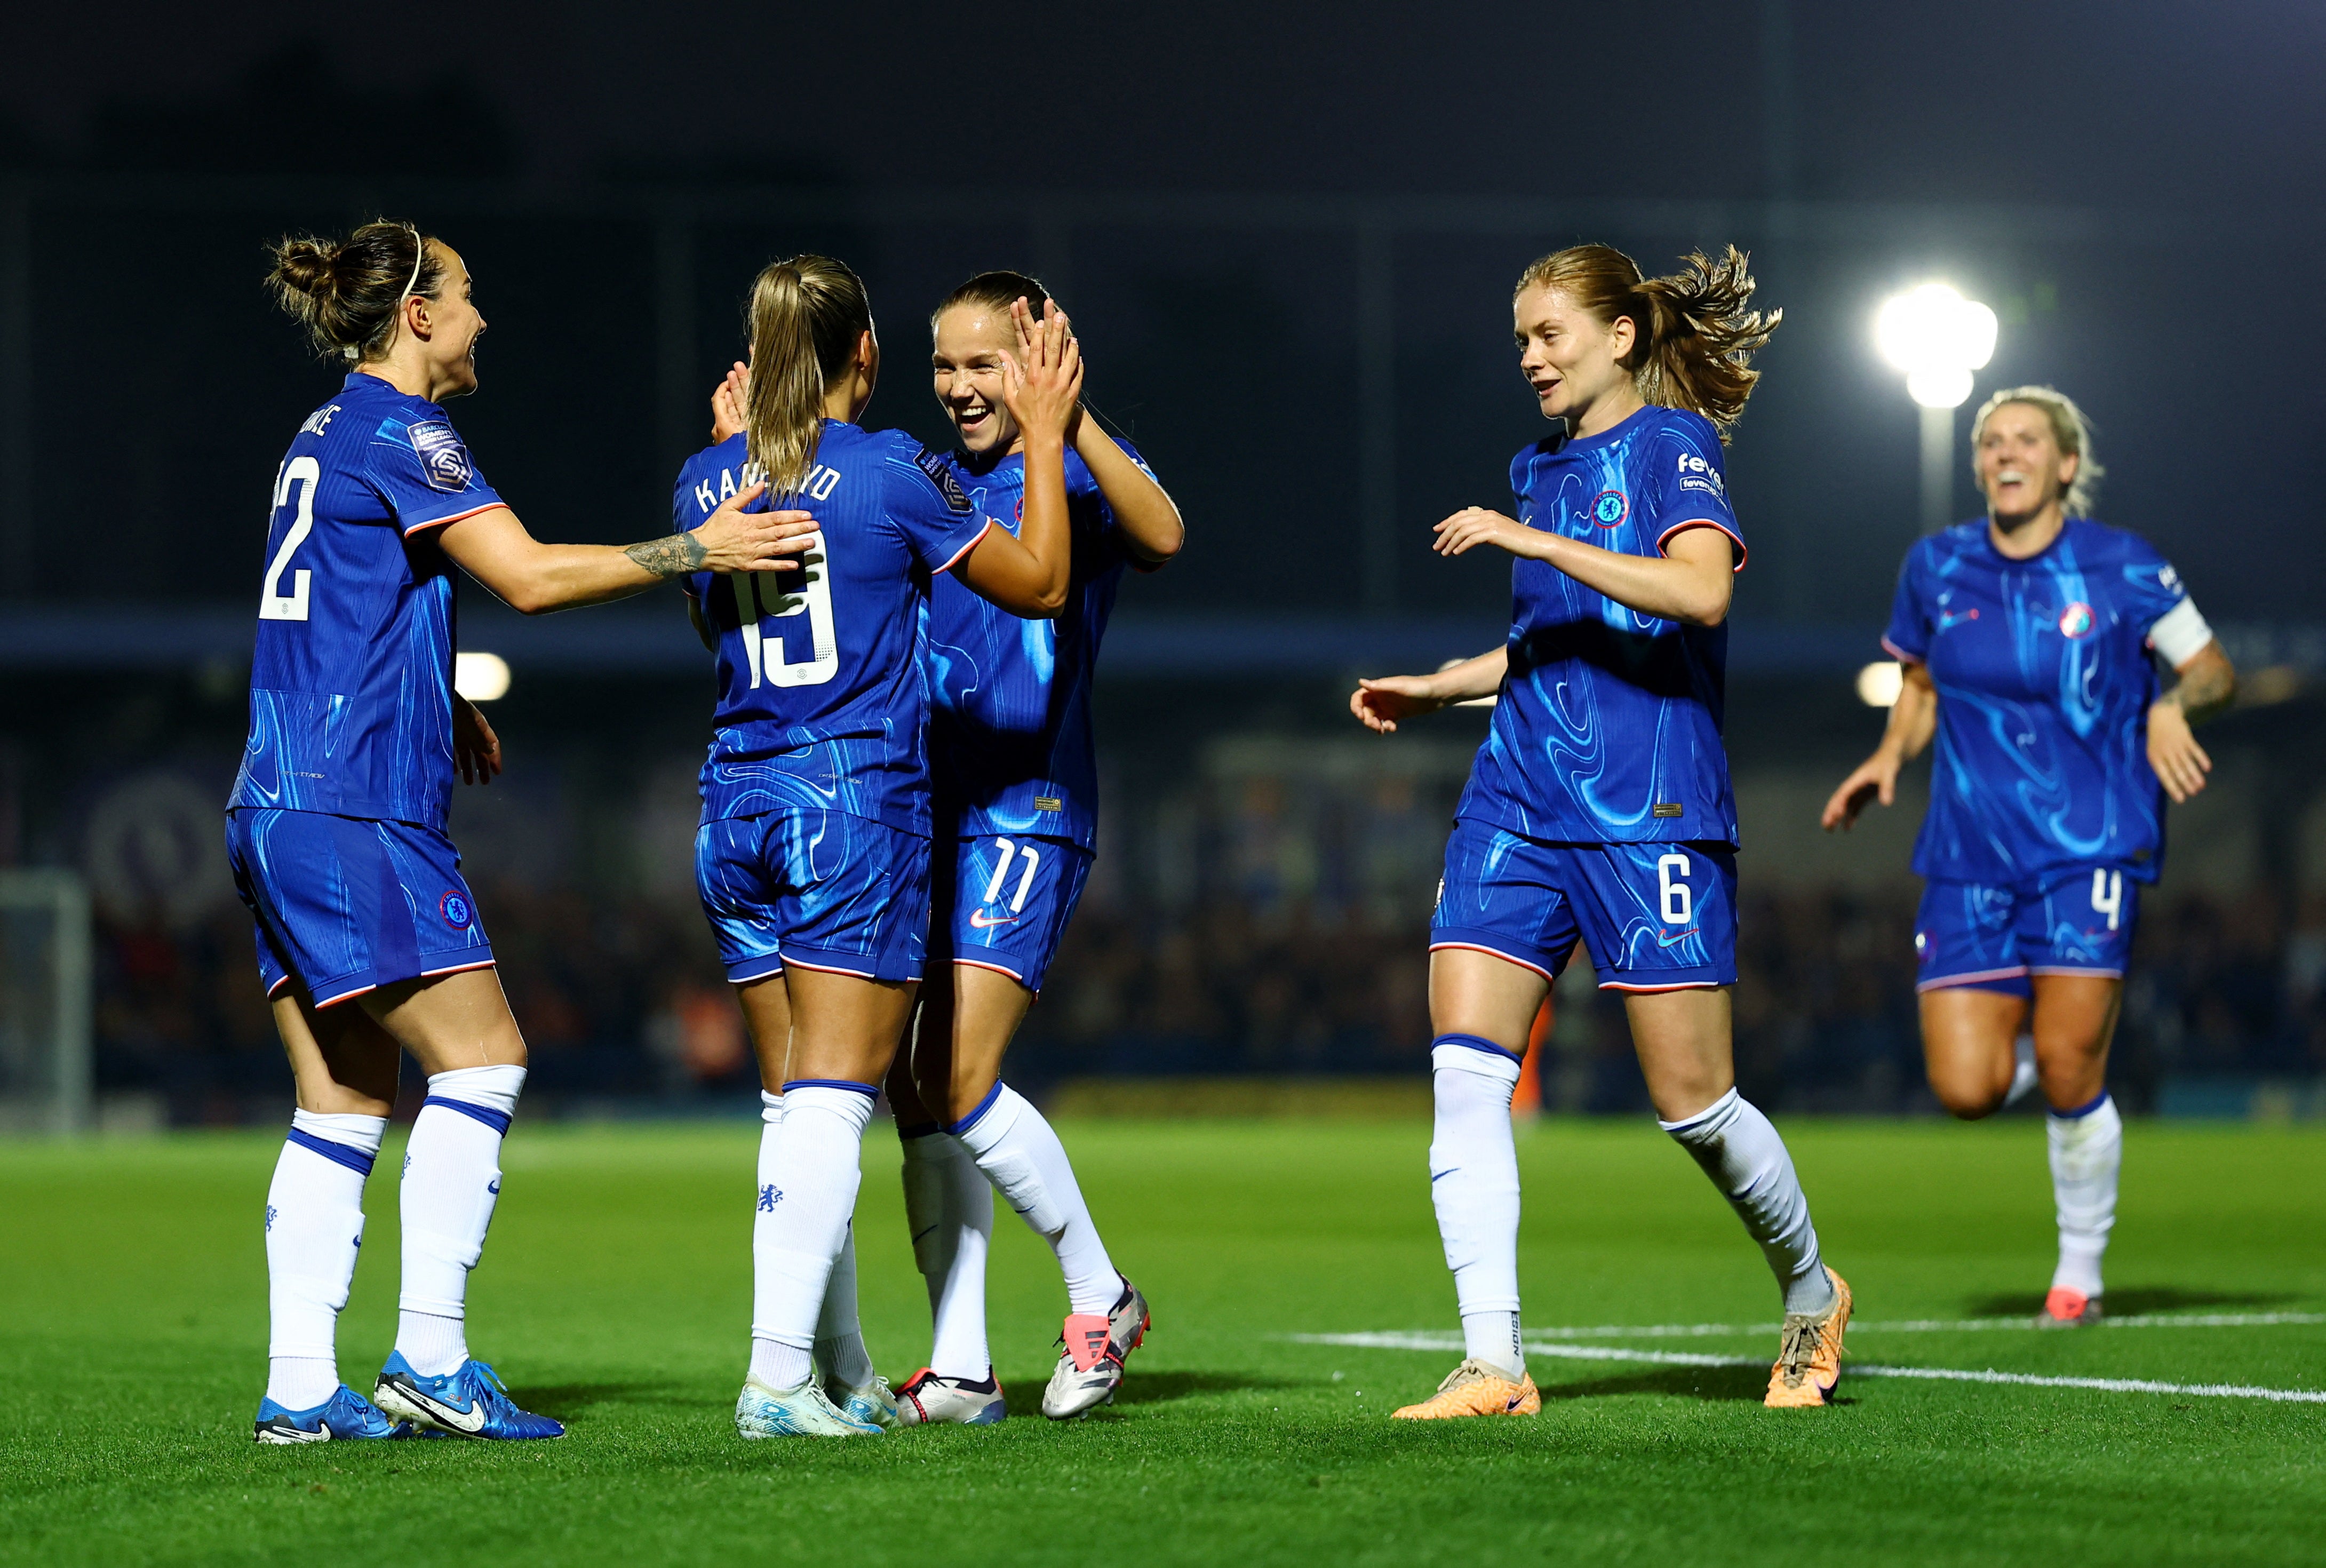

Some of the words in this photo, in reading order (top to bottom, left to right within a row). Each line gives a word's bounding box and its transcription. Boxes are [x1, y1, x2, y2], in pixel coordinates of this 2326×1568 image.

[258, 456, 320, 621] 2
[983, 837, 1040, 913] 11
[1658, 853, 1692, 924] 6
[2091, 867, 2122, 931] 4
